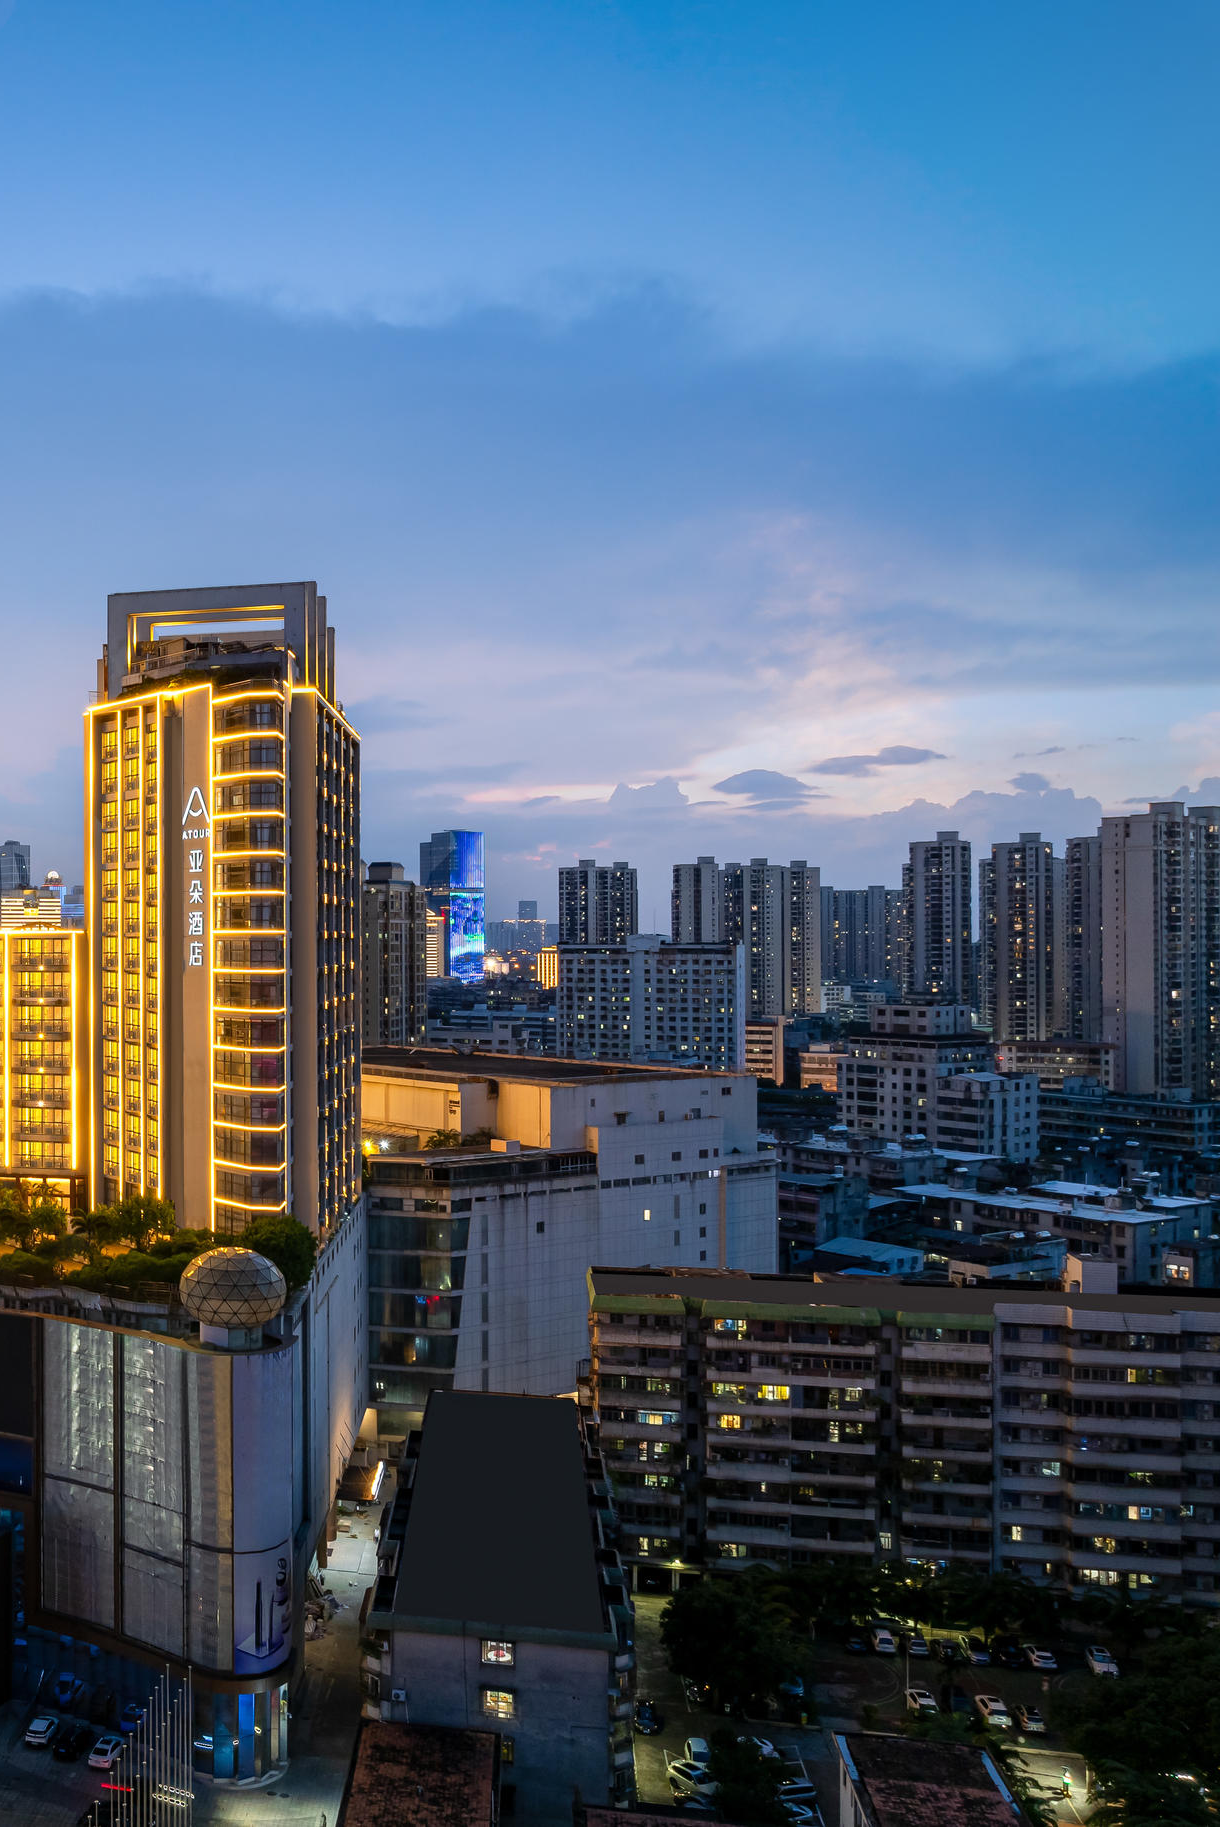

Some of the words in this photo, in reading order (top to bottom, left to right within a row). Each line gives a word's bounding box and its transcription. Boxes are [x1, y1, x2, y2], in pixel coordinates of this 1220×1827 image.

[182, 828, 211, 840] ATOUR
[188, 849, 204, 967] 亚朵酒店
